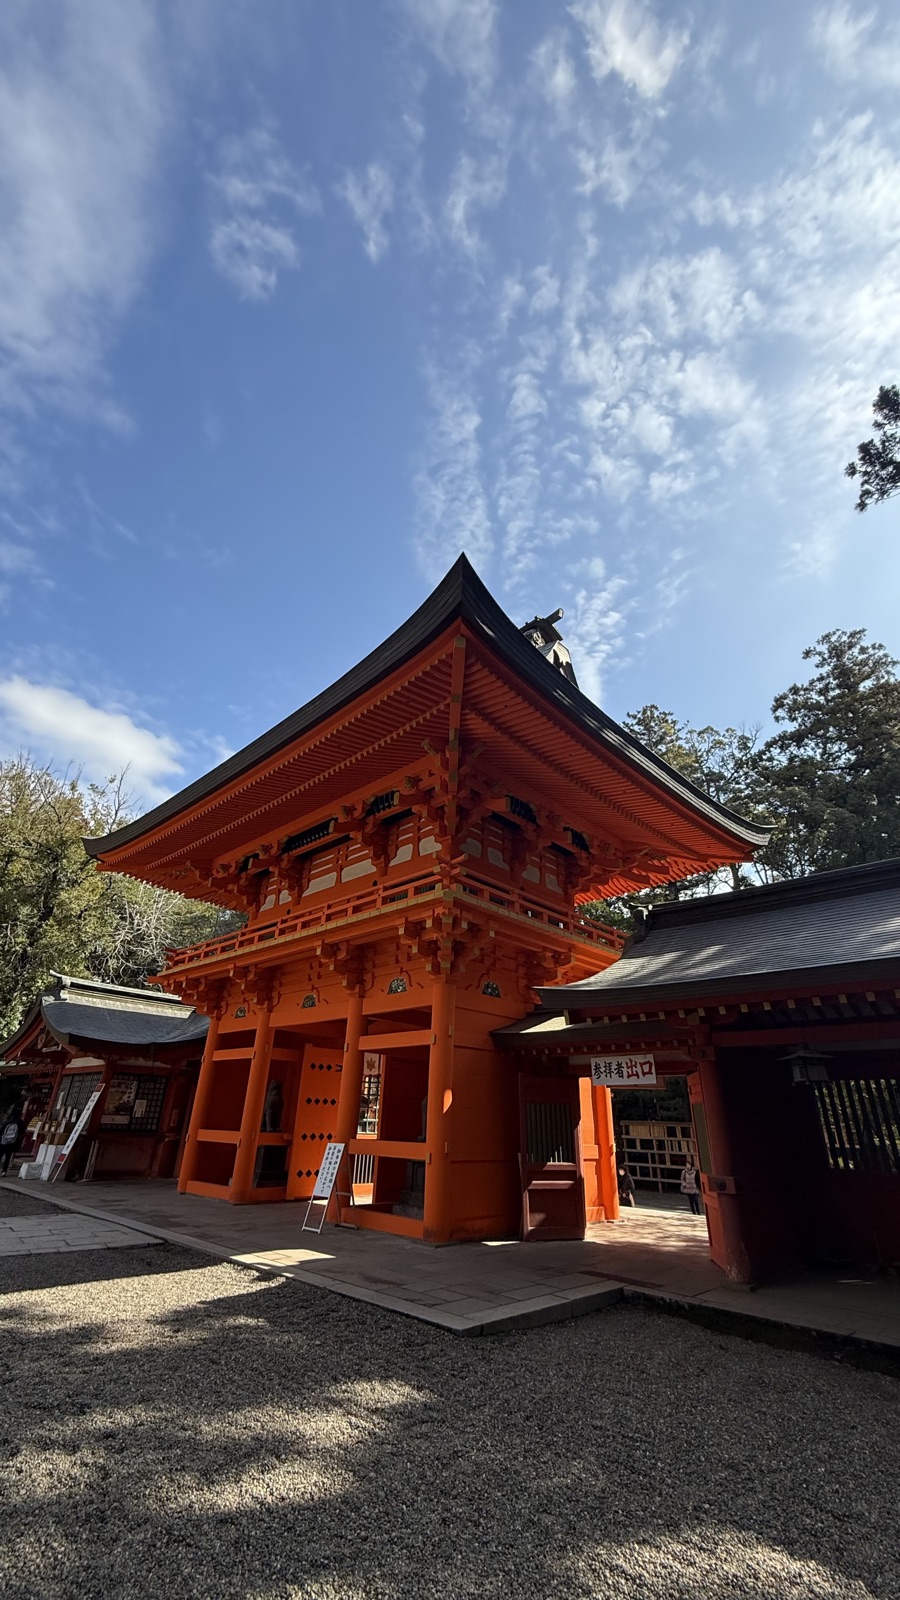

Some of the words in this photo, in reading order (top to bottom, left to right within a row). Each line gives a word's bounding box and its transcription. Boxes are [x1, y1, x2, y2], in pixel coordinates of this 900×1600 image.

[593, 1058, 654, 1080] 参拝者出口
